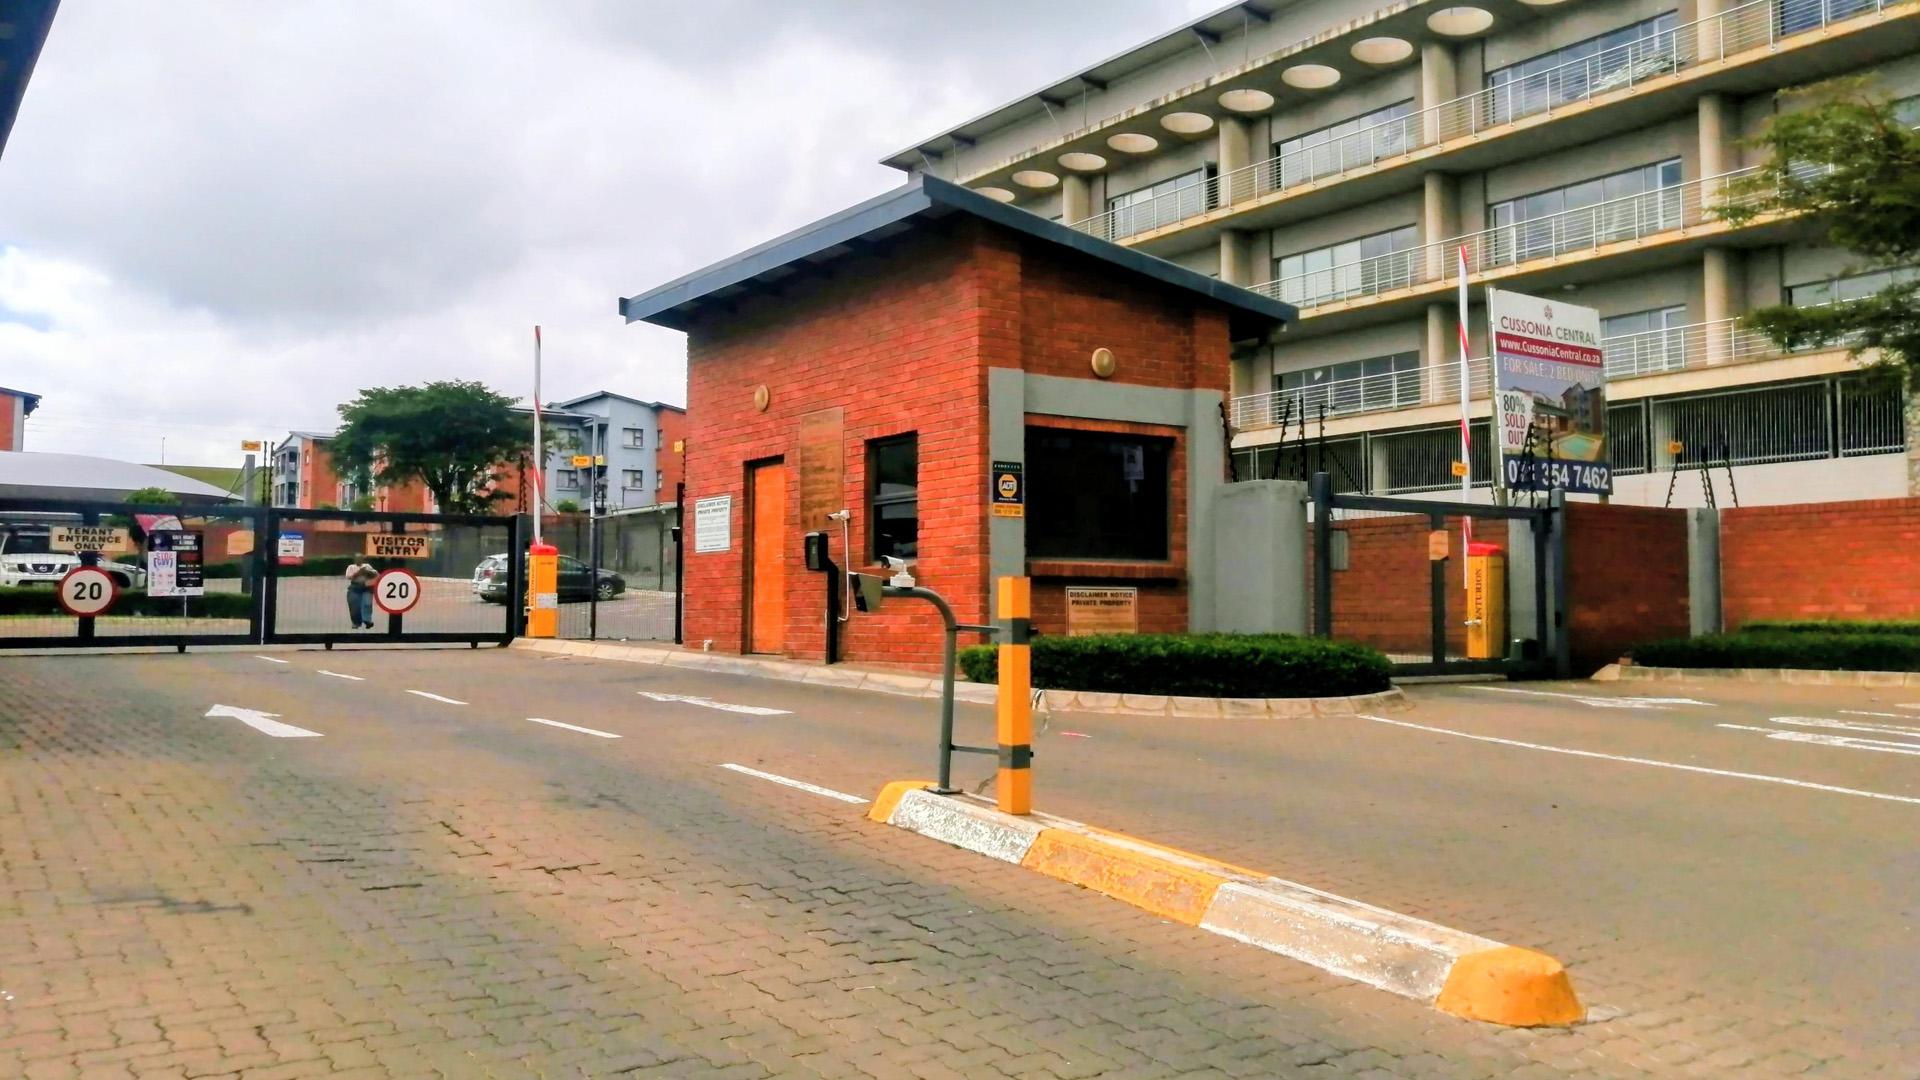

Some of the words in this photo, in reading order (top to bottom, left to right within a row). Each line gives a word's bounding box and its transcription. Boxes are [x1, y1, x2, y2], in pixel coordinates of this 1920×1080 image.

[1500, 316, 1553, 338] CUSSONIA
[1556, 327, 1597, 345] CENTRAL
[1500, 339, 1601, 364] www.CussoniaCentral.co.za
[1503, 356, 1521, 373] FOR
[1550, 365, 1555, 379] 2
[1557, 366, 1573, 383] BED
[1503, 394, 1526, 414] 80%
[1505, 413, 1526, 429] SOLD
[1508, 430, 1524, 446] OUT
[1541, 462, 1570, 487] 354
[1573, 465, 1609, 490] 7462
[1002, 481, 1014, 490] ADT
[58, 535, 121, 544] ENTRANCE
[67, 527, 114, 536] TENANT
[372, 536, 425, 546] VISITOR
[376, 546, 420, 555] ENTRY
[73, 582, 103, 600] 20
[386, 582, 409, 599] 20
